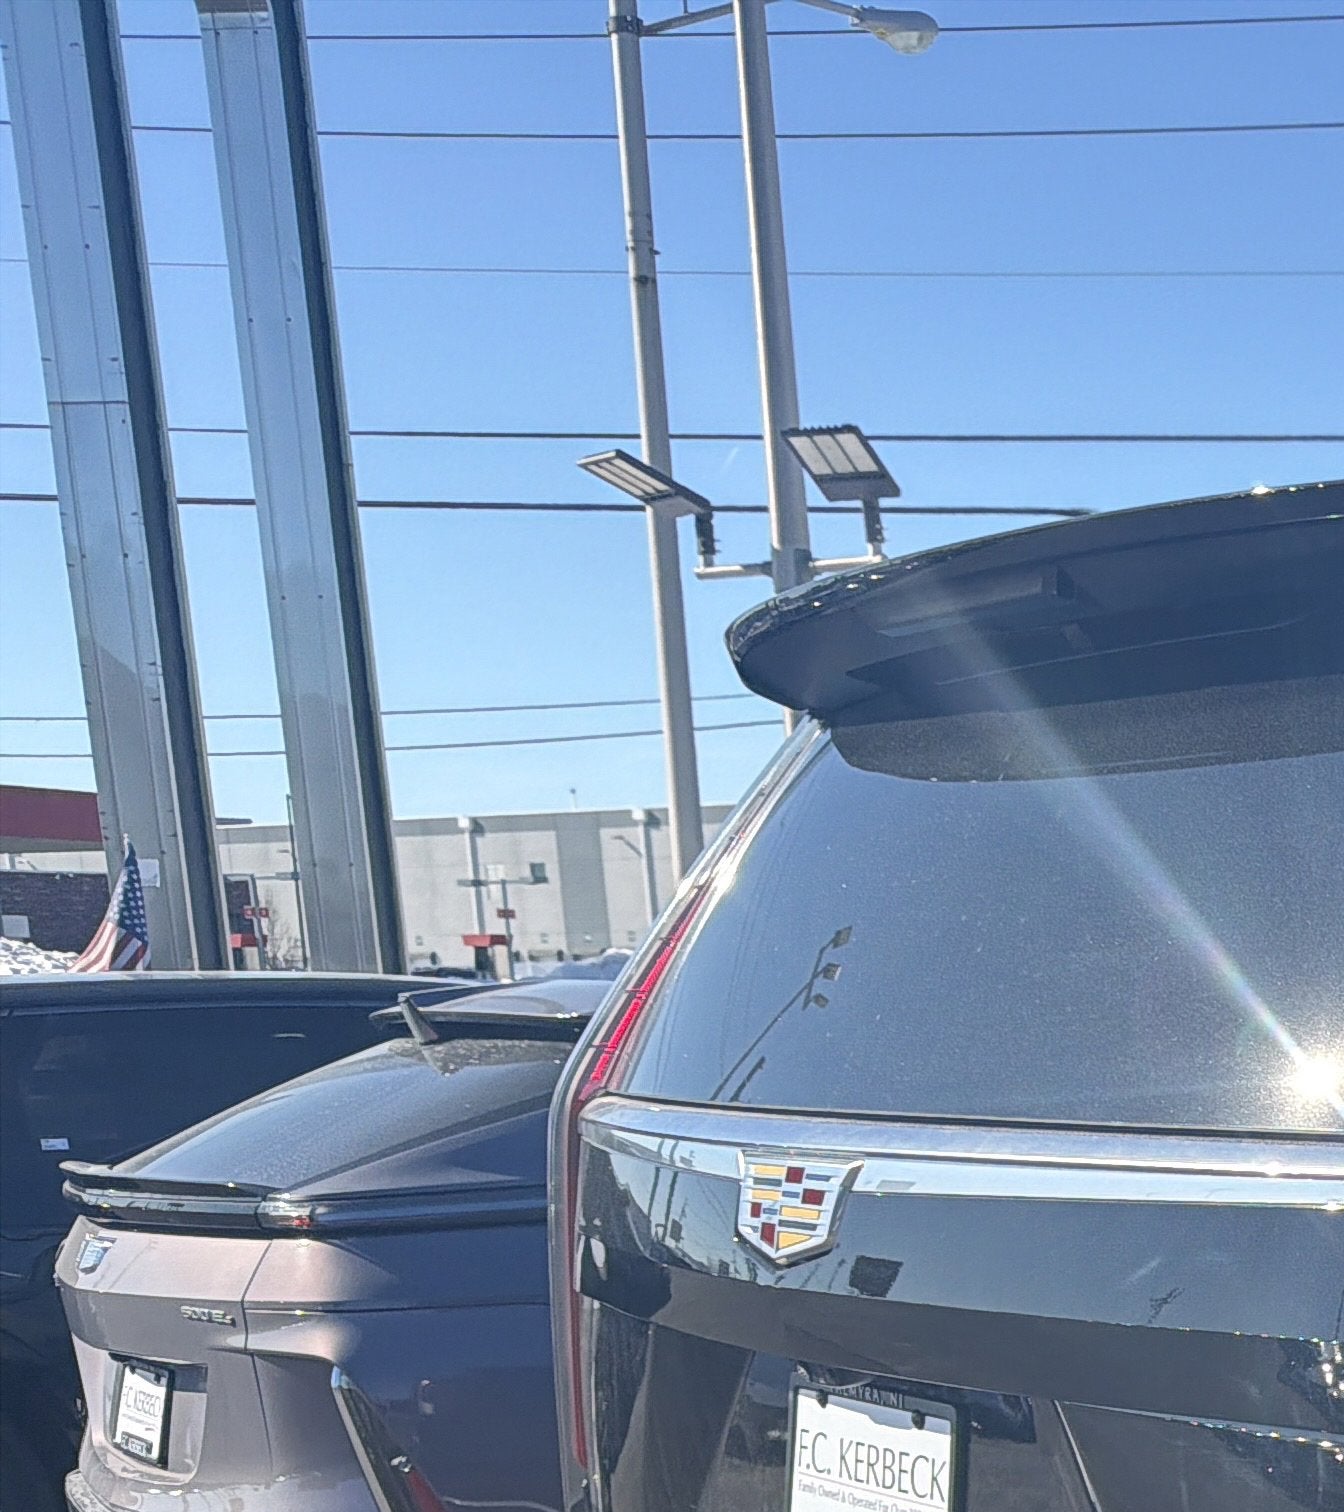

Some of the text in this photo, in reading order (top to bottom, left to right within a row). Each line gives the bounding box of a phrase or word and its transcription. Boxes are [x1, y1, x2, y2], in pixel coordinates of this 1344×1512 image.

[797, 1427, 947, 1504] F.C. KERBECK
[797, 1478, 817, 1497] Family
[818, 1484, 841, 1502] Owned
[847, 1492, 878, 1512] Operated
